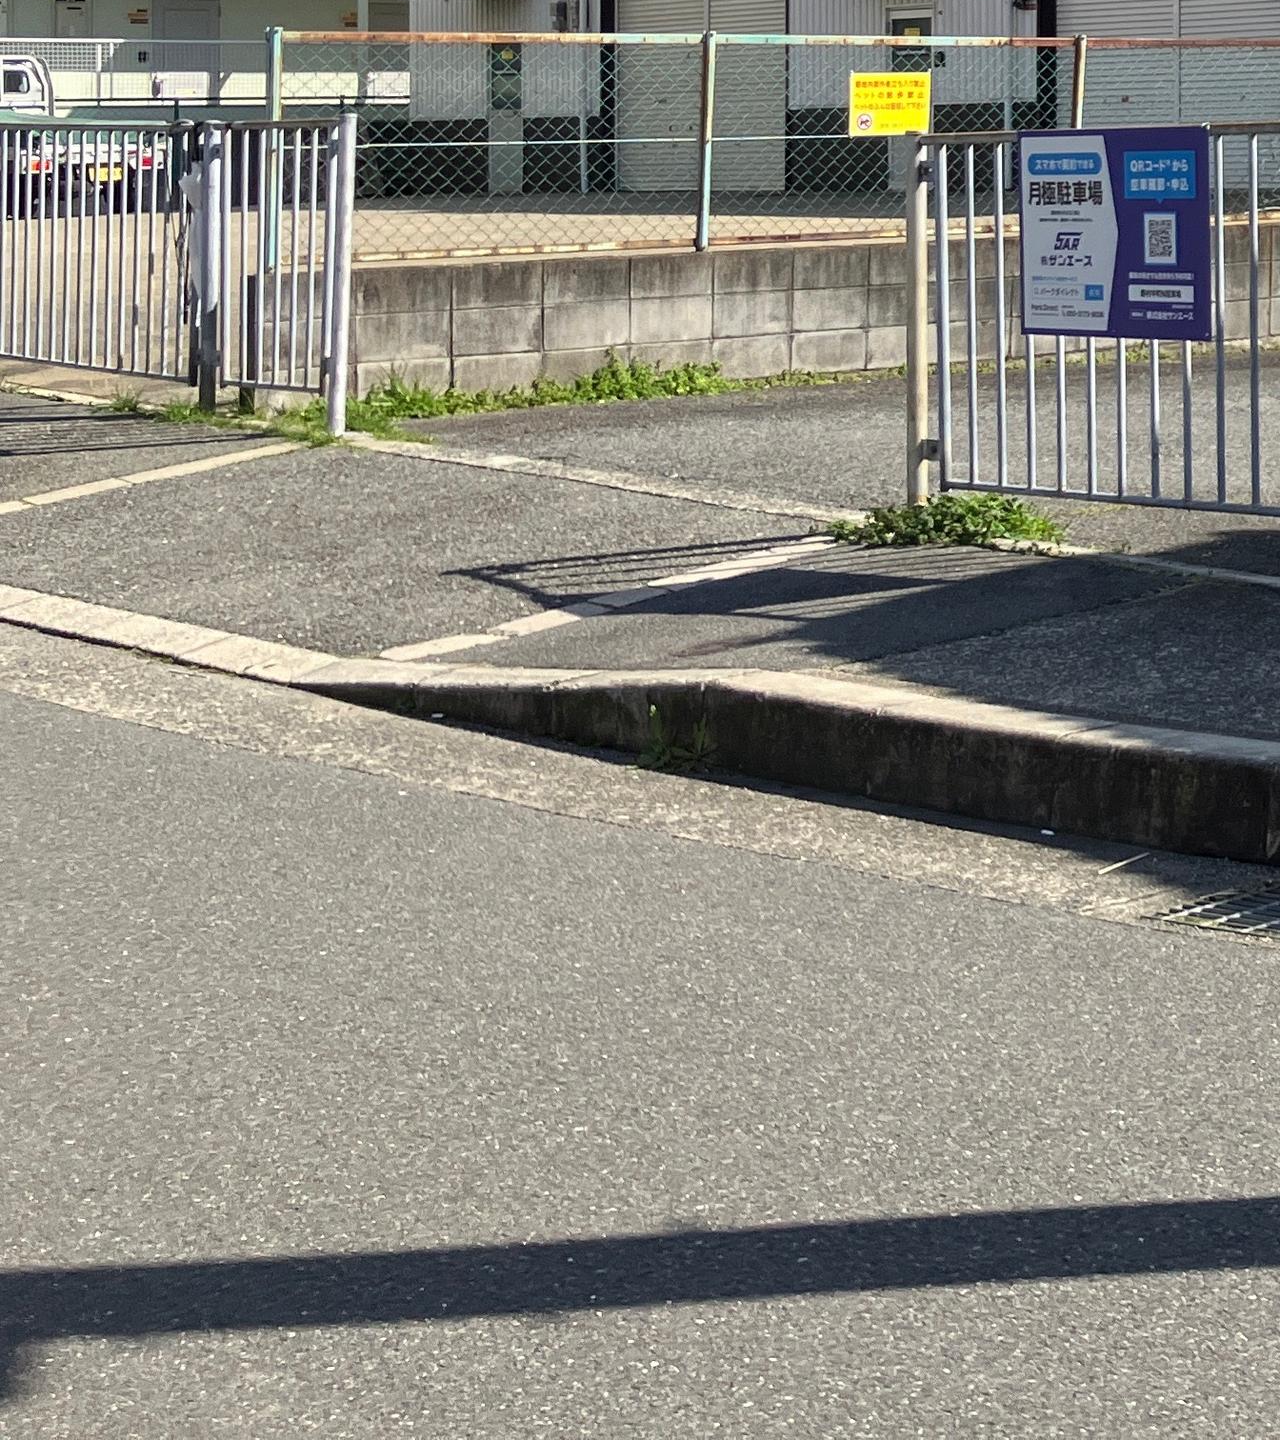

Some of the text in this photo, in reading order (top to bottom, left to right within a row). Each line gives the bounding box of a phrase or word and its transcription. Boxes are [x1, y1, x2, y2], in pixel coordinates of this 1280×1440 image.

[1029, 180, 1103, 206] 月極駐車場
[1054, 232, 1083, 250] SAR
